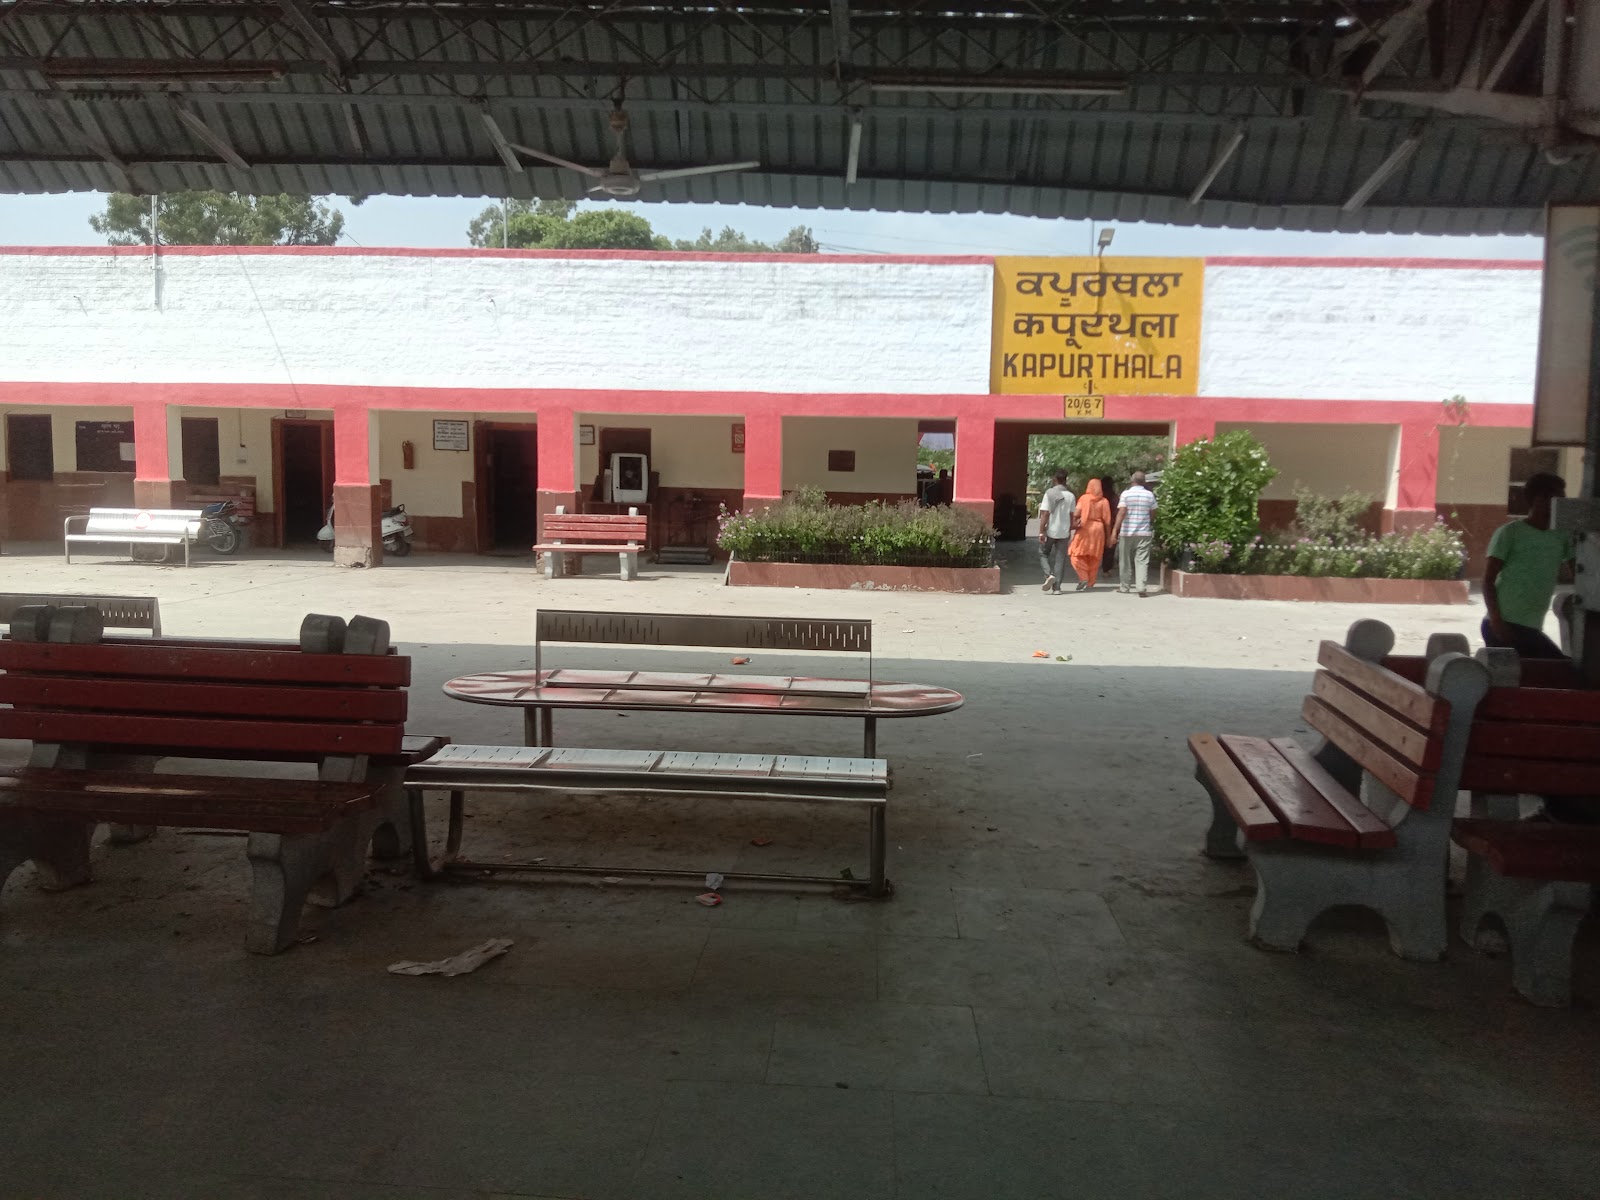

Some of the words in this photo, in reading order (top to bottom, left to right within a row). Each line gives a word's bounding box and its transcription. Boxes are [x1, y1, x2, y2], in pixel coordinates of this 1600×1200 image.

[1016, 271, 1183, 307] ਕਪੂਰਥਲਾ
[1013, 312, 1179, 350] कपूरथला
[1003, 352, 1182, 379] KAPURTHALA
